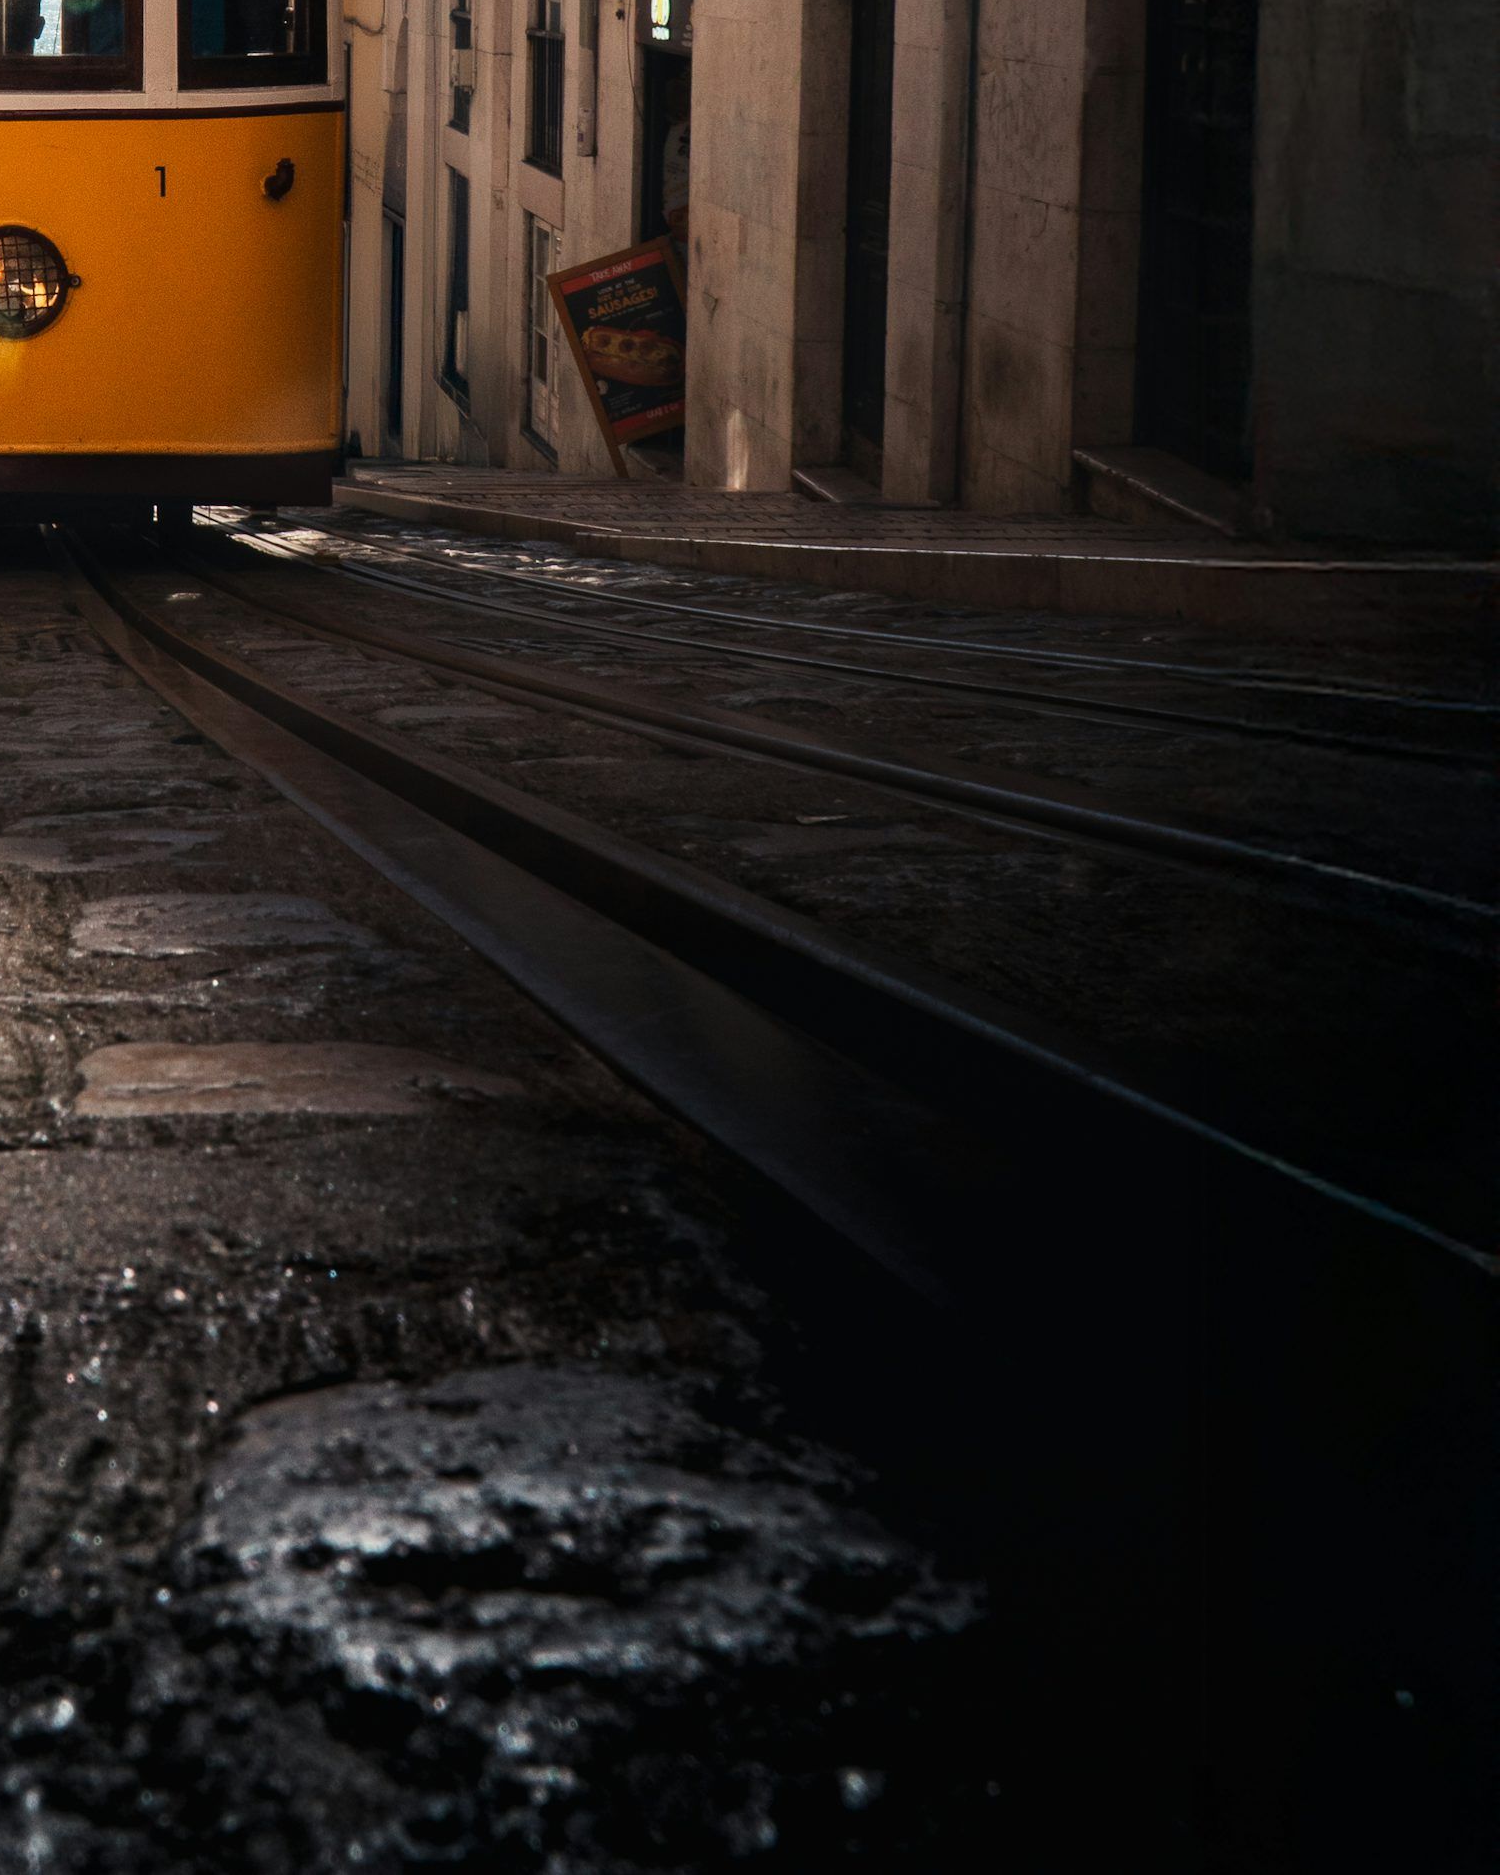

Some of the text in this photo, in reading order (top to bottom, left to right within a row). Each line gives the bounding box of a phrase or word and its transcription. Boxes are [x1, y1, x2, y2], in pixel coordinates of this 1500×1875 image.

[155, 166, 166, 197] 1
[589, 261, 633, 283] TAKE AWAY
[587, 286, 658, 319] SAUSAGES!
